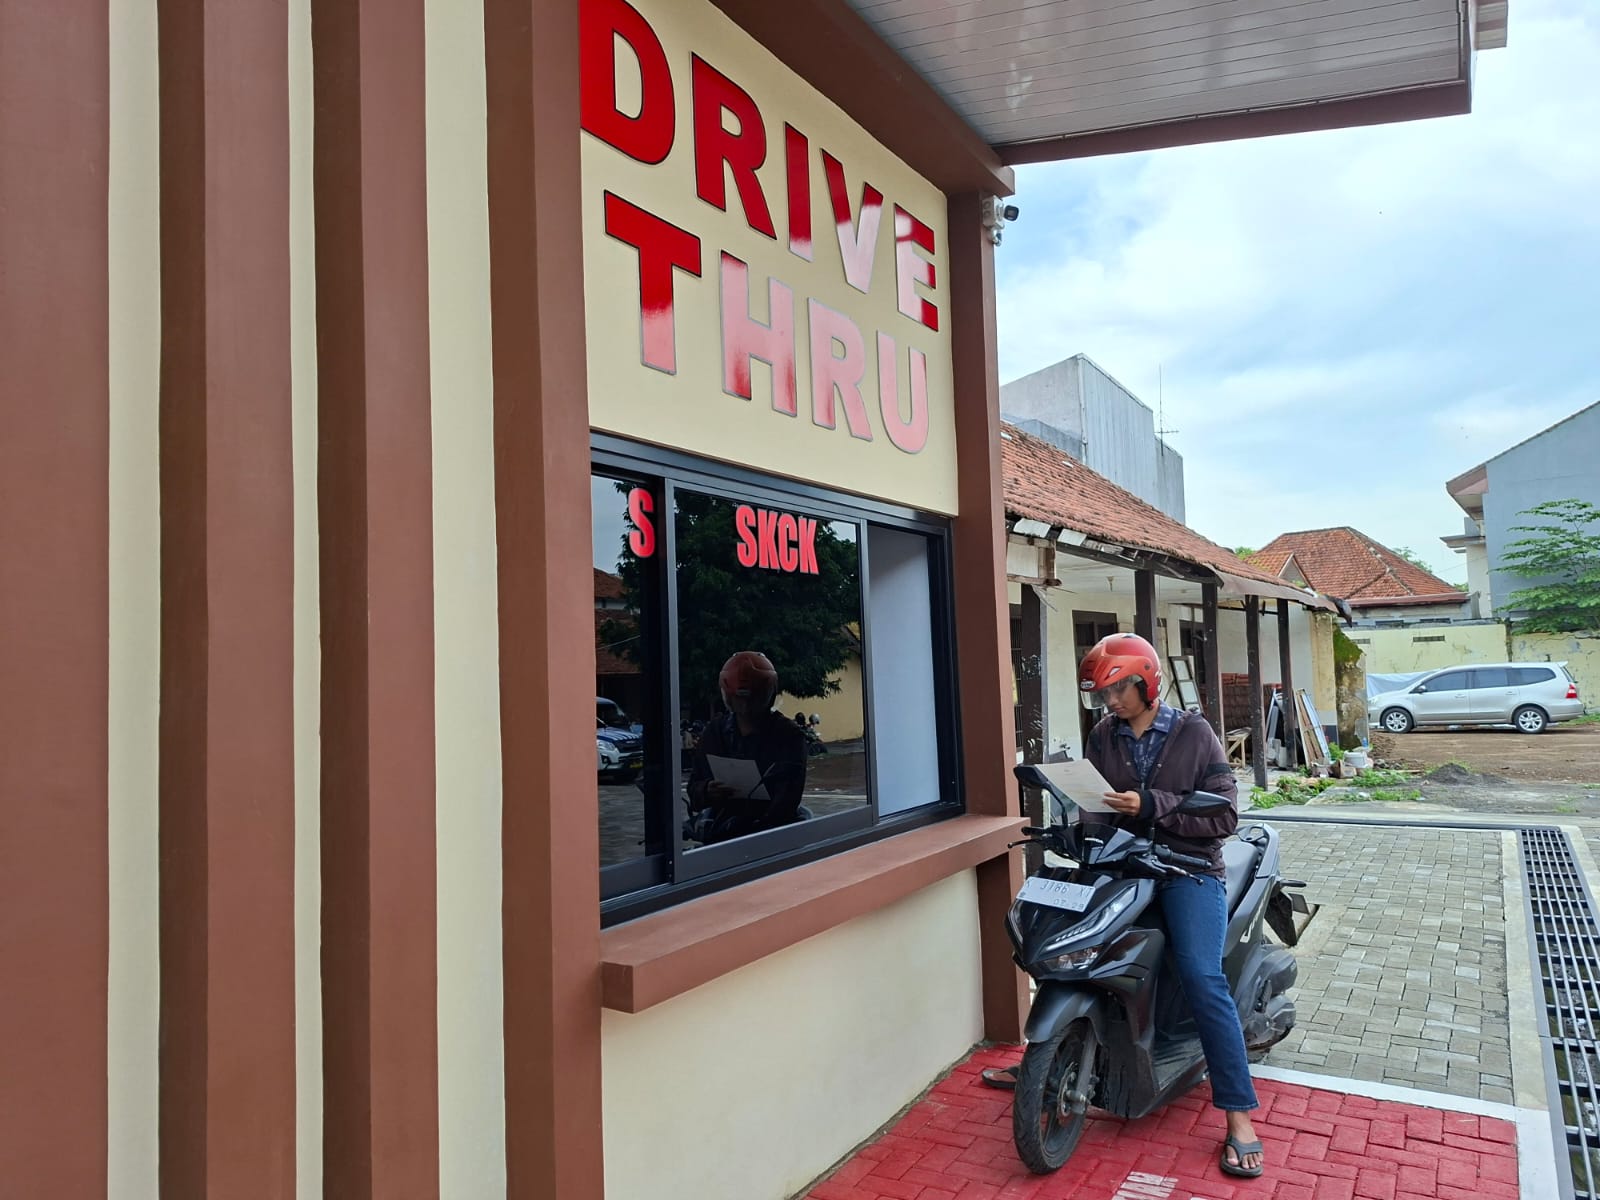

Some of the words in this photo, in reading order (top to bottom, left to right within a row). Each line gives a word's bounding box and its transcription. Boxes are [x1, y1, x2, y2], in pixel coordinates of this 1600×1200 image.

[580, 0, 938, 332] DRIVE
[604, 190, 929, 454] THRU
[735, 504, 819, 575] SKCK
